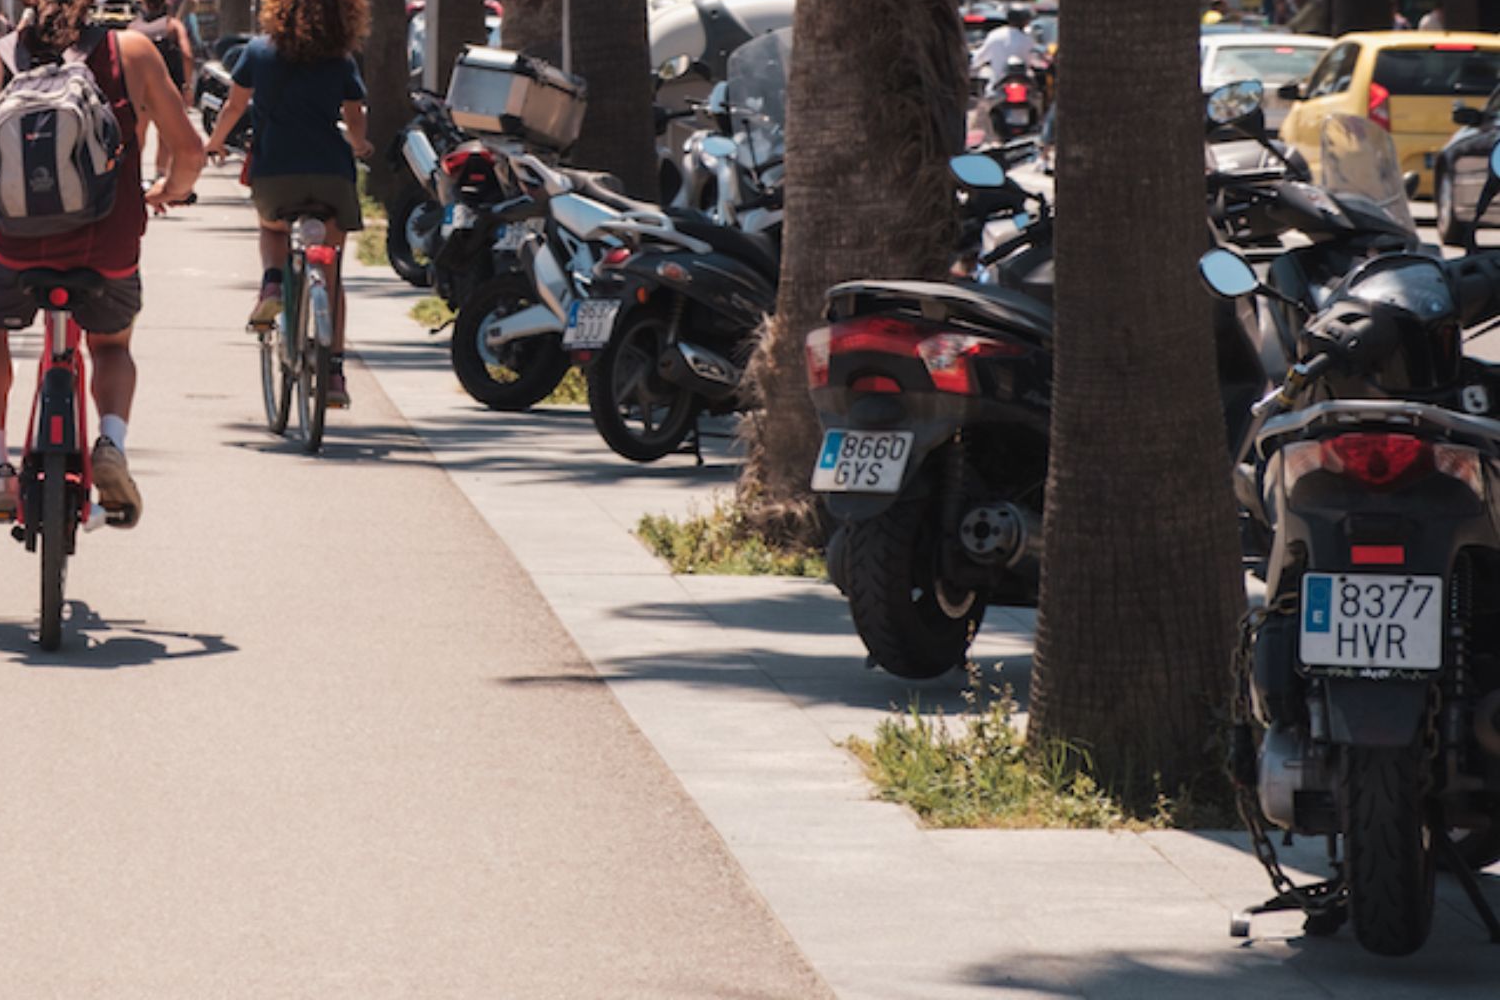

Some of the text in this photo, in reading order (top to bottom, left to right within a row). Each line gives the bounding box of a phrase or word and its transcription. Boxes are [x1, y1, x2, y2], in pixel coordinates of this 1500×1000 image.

[842, 435, 906, 460] 8660
[834, 461, 883, 486] GYS
[1340, 584, 1434, 619] 8377
[1312, 610, 1324, 624] E
[1337, 622, 1407, 660] HVR
